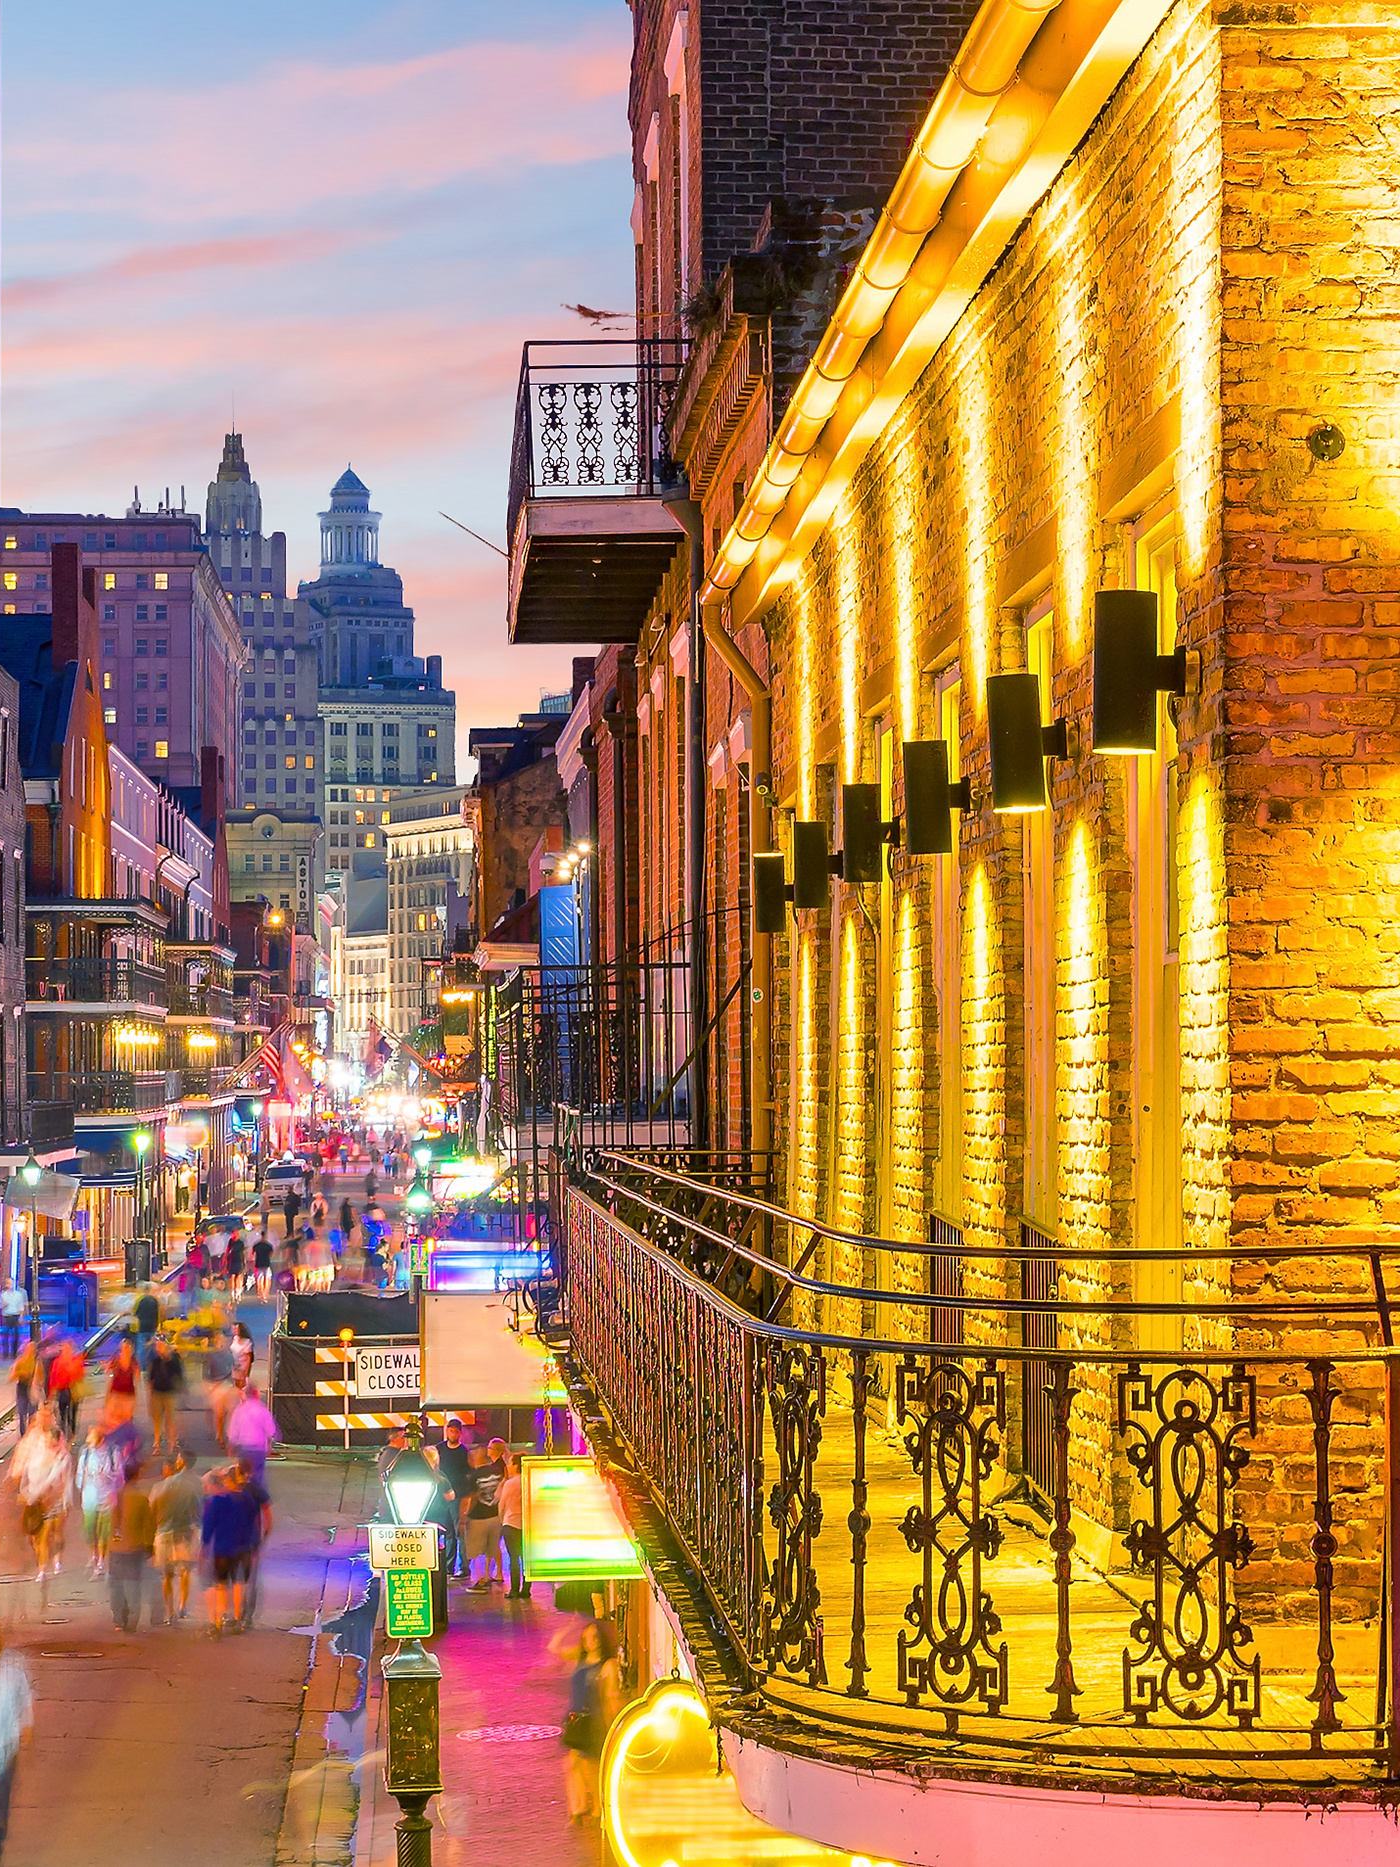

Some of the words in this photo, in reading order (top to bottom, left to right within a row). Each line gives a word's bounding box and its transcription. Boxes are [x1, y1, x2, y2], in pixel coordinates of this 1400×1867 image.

[299, 857, 307, 910] ASTOR
[360, 1354, 420, 1370] SIDEWAL
[368, 1374, 420, 1390] CLOSED
[378, 1530, 427, 1539] SIDEWALK
[384, 1543, 423, 1553] CLOSED
[391, 1557, 417, 1566] HERE
